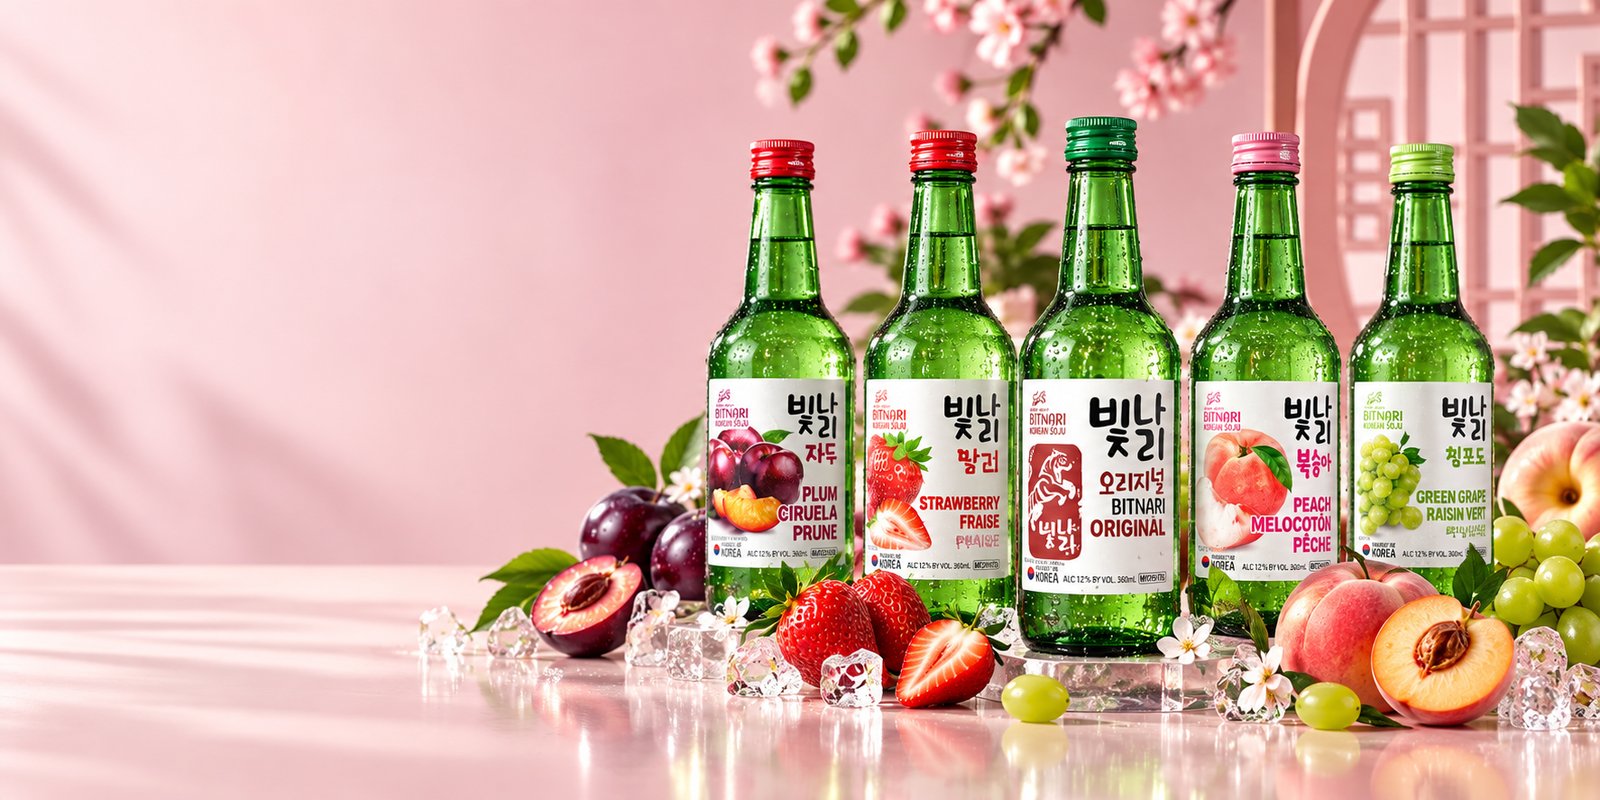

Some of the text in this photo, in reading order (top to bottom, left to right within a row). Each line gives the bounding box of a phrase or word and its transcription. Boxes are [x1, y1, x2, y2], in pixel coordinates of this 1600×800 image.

[715, 408, 748, 419] BITNARI
[873, 410, 906, 421] BITNARI
[1030, 413, 1066, 426] BITNARI
[1204, 412, 1240, 422] BITNARI
[1363, 411, 1402, 421] BITNARI
[1050, 427, 1066, 435] SOJU
[805, 443, 837, 465] 자두
[1296, 449, 1332, 479] 복숭아
[1099, 467, 1164, 494] 오리지널
[802, 486, 837, 502] PLUM
[1416, 490, 1486, 504] GREEN GRAPE
[920, 496, 1000, 510] STRAWBERRY
[1112, 498, 1165, 515] BITNARI
[1293, 496, 1331, 512] PEACH
[778, 505, 837, 522] CIRUELA
[1427, 507, 1486, 521] RAISIN VERT
[960, 514, 1000, 529] FRAISE
[1090, 518, 1166, 537] ORIGINAL
[1252, 514, 1331, 532] MELOCOTÓN
[793, 524, 837, 541] PRUNE
[1293, 533, 1331, 553] PÊCHE
[1372, 549, 1396, 558] KOREA
[1036, 572, 1059, 583] KOREA
